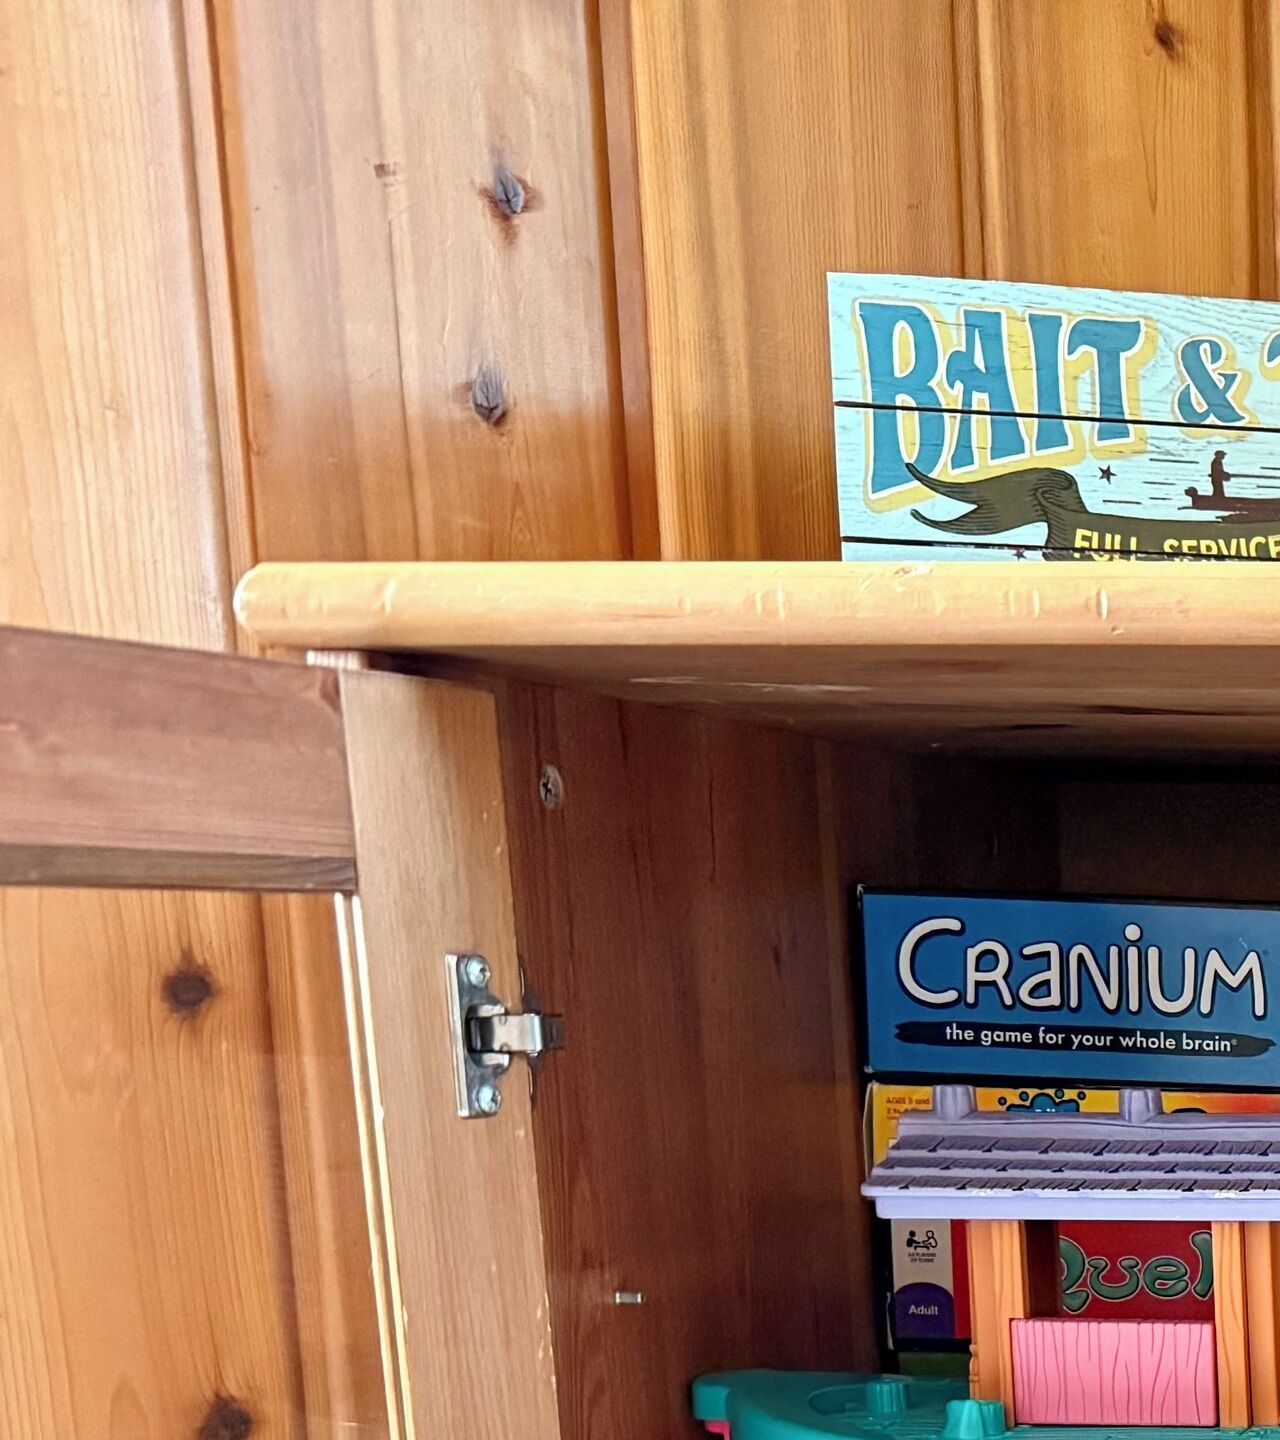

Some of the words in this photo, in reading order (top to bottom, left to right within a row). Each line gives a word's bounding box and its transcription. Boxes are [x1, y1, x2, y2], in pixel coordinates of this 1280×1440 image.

[855, 300, 1143, 494] BAIT
[1179, 336, 1248, 426] &
[946, 1023, 975, 1041] the
[980, 1029, 1033, 1046] game
[1038, 1026, 1066, 1045] for
[1070, 1034, 1114, 1050] your
[1118, 1031, 1177, 1050] whole
[908, 1304, 939, 1316] Adult
